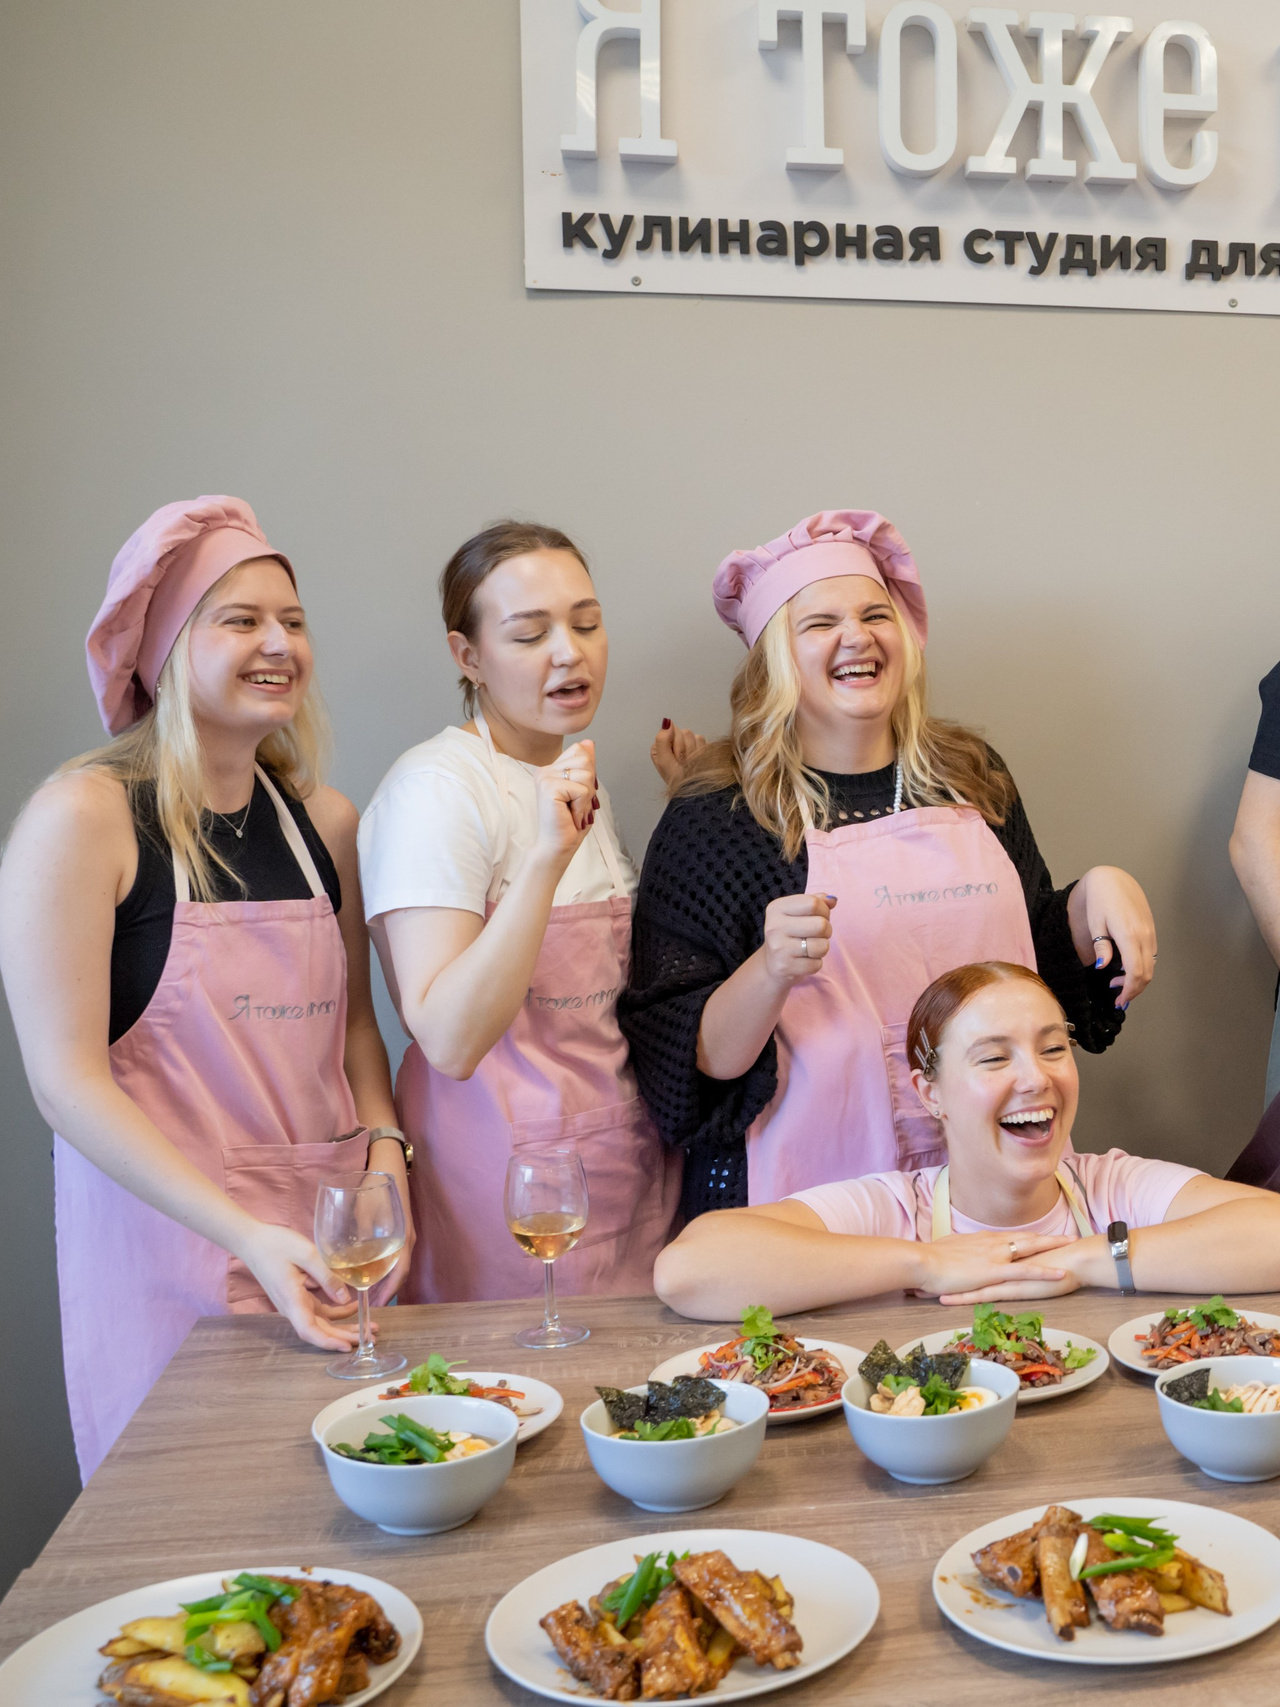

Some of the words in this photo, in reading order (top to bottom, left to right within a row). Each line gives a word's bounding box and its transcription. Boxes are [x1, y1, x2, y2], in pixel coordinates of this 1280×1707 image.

[758, 0, 1218, 191] тоже
[561, 211, 941, 266] кулинарная
[963, 227, 1167, 277] студия
[873, 885, 893, 908] Я
[227, 994, 251, 1021] Я
